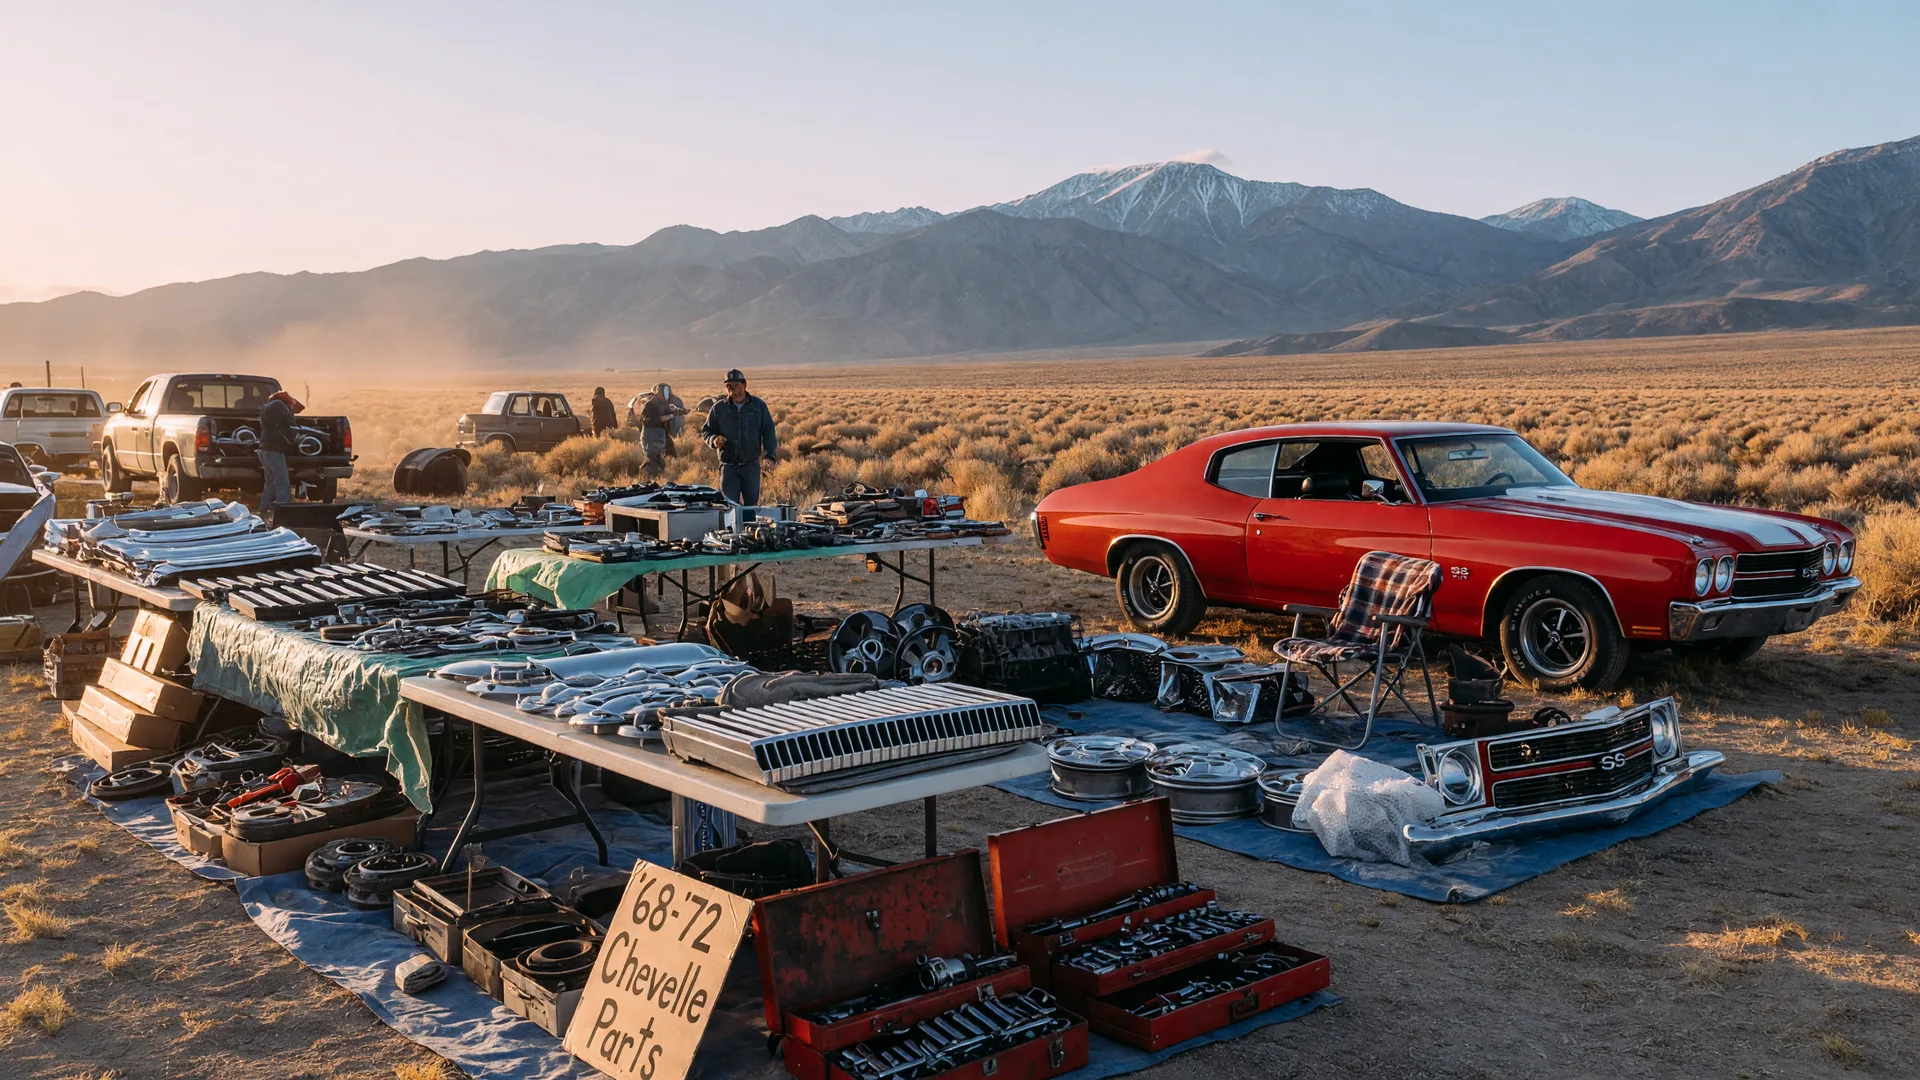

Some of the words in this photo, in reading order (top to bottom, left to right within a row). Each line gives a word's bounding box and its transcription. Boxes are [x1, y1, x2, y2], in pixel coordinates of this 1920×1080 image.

[1601, 752, 1626, 770] SS
[632, 872, 723, 954] '68-'72
[601, 931, 708, 1023] Chevelle
[586, 997, 663, 1080] Parts
